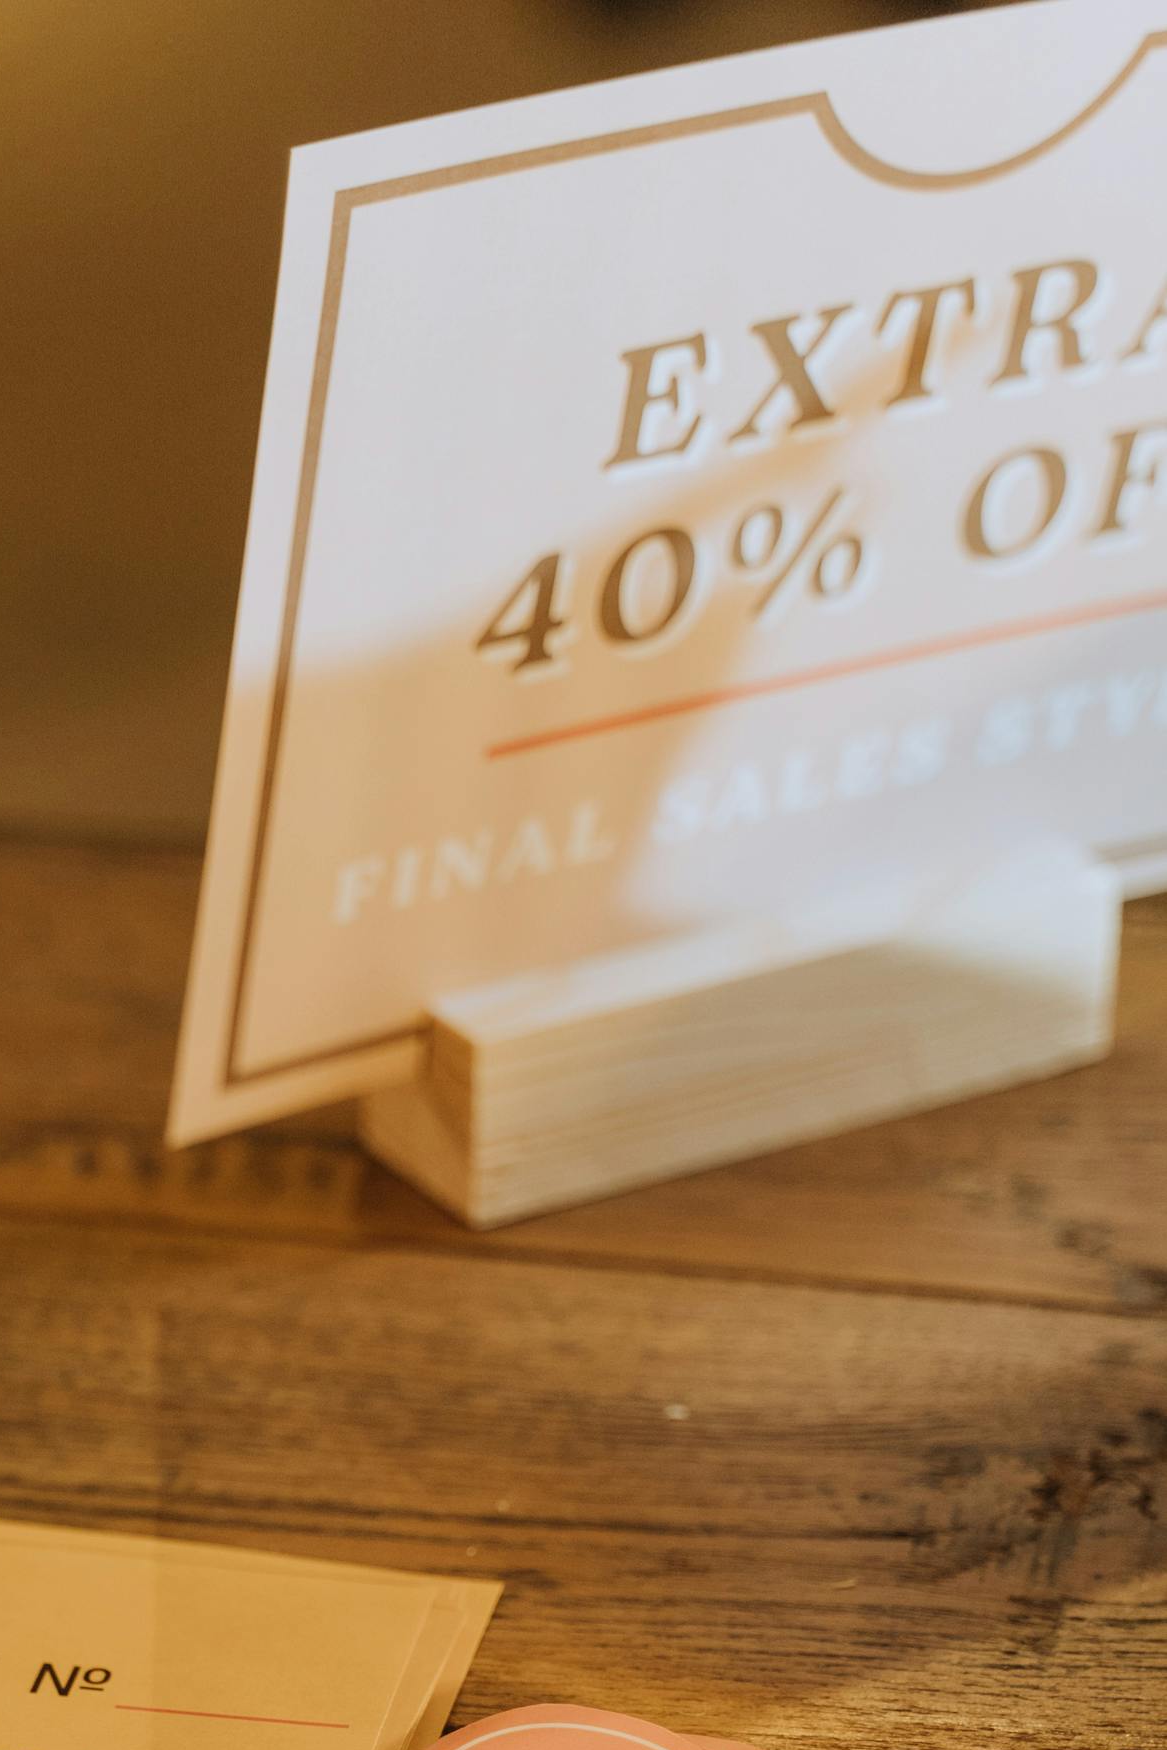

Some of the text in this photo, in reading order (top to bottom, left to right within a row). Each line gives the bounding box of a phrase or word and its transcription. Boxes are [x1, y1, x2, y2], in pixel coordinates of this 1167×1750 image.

[474, 488, 864, 673] 40%
[331, 804, 618, 926] FINAL
[652, 720, 948, 846] SALES
